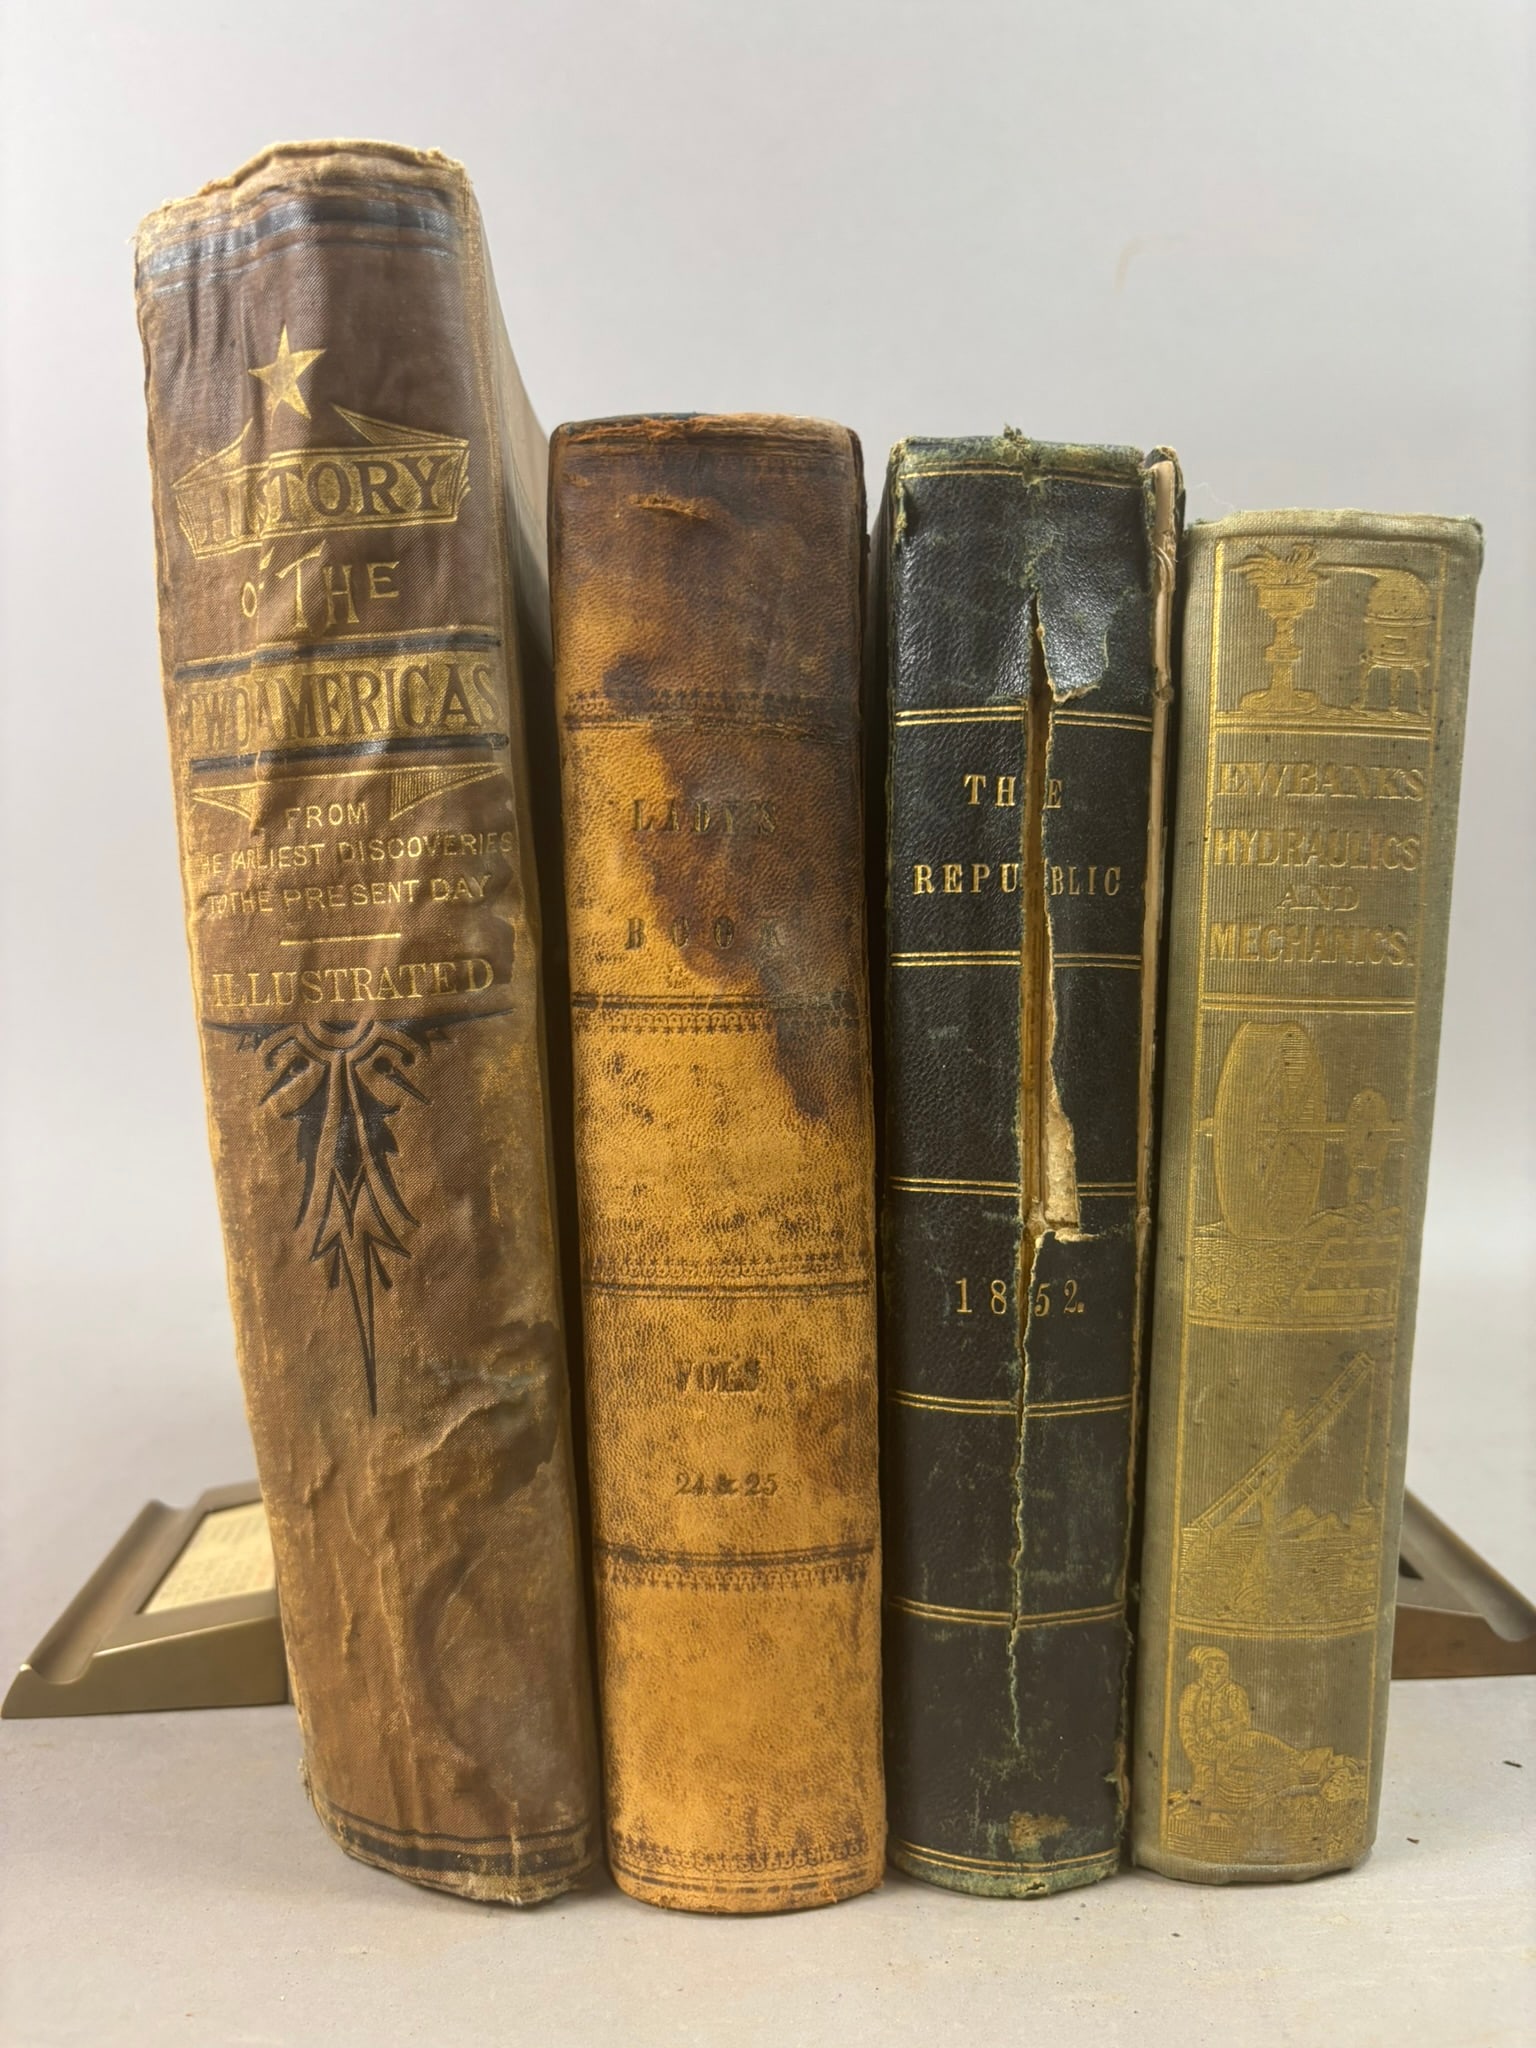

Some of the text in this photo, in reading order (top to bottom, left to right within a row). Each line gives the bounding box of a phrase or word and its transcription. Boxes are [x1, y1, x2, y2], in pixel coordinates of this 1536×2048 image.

[276, 540, 400, 629] THE
[254, 662, 501, 744] AMERICAS
[963, 773, 1063, 810] THE
[285, 803, 369, 829] FROM
[336, 831, 514, 862] DISCOVERIES
[1213, 829, 1421, 871] HYDRAULICS
[206, 875, 493, 914] TO THE PRESENT DAY
[912, 863, 1121, 897] REPUBLIC
[1276, 884, 1360, 911] AND
[624, 915, 784, 951] BOOK
[211, 958, 495, 1008] ILLUSTRATED
[674, 1472, 708, 1497] 24
[744, 1472, 779, 1497] 25
